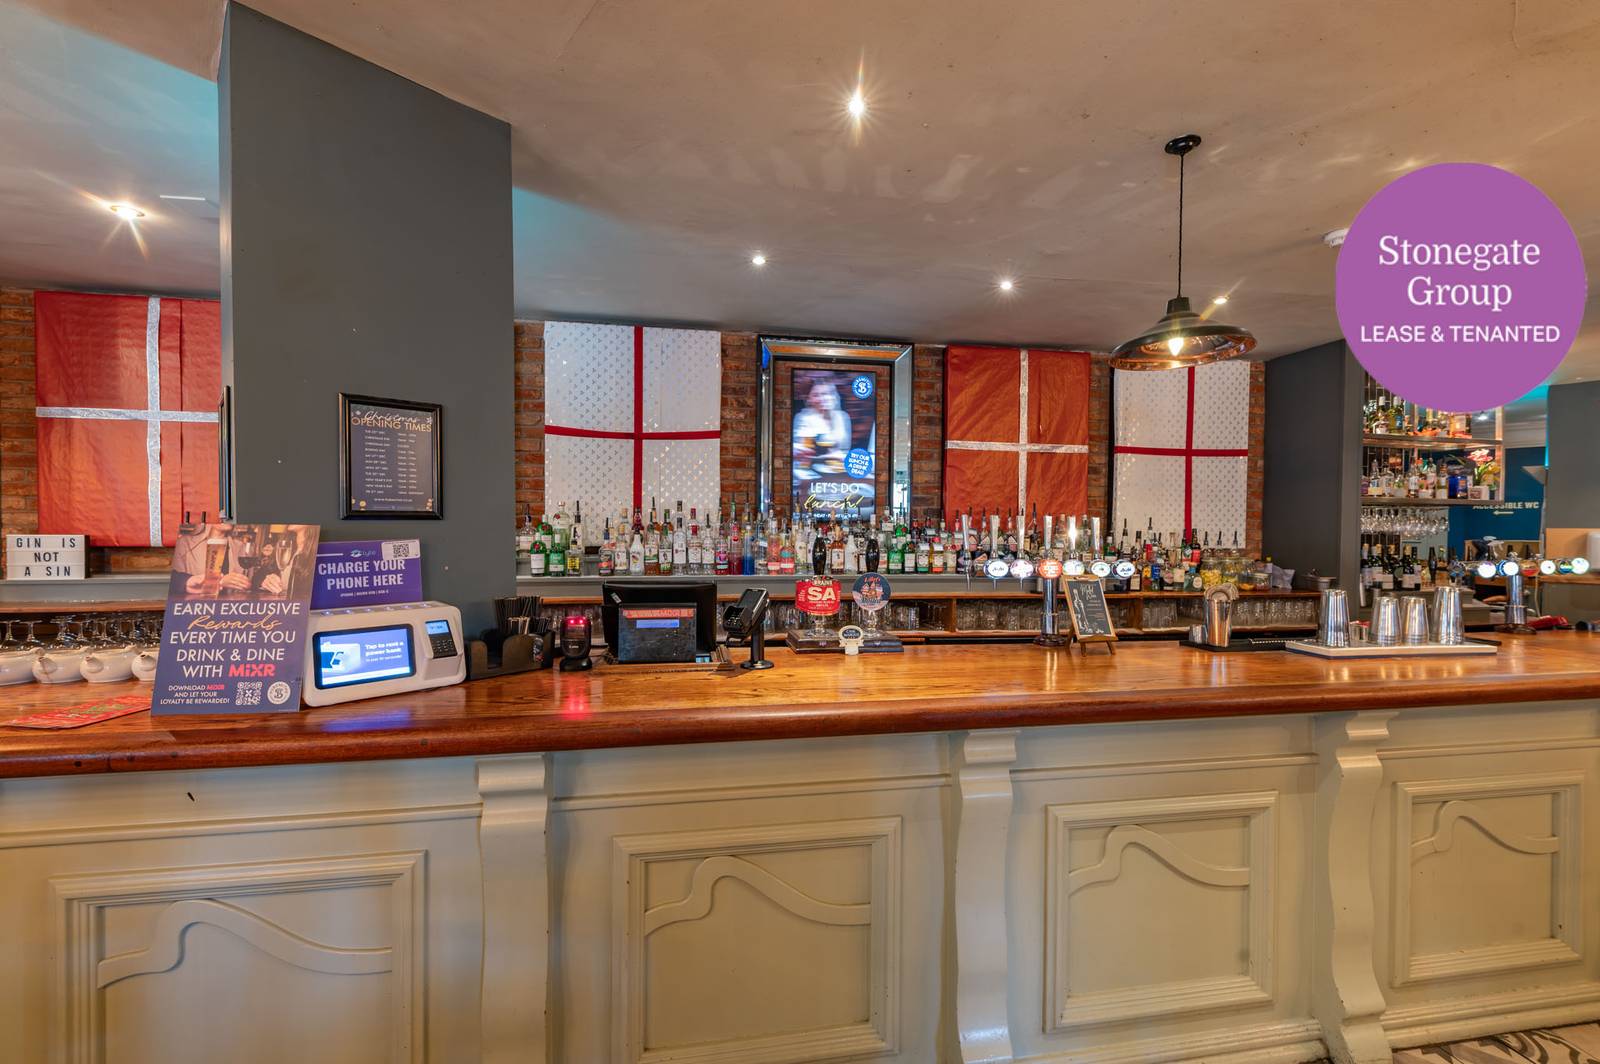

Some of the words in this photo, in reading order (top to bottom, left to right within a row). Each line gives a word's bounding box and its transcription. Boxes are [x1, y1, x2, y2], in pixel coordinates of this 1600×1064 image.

[351, 416, 401, 429] OPENING
[404, 422, 432, 432] TIMES
[840, 482, 860, 493] DO
[16, 537, 42, 548] GIN
[62, 537, 76, 548] IS
[34, 552, 59, 563] NOT
[24, 566, 31, 576] A
[46, 566, 71, 577] SIN
[318, 561, 370, 575] CHARGE
[373, 559, 405, 572] YOUR
[326, 576, 369, 590] PHONE
[373, 573, 404, 586] HERE
[807, 586, 837, 601] SA
[173, 602, 216, 615] EARN
[220, 602, 301, 616] EXCLUSIVE
[187, 614, 282, 631] Rewards
[170, 631, 217, 644] EVERY
[220, 631, 257, 644] TIME
[262, 630, 296, 643] YOU
[176, 649, 226, 662] DRINK
[230, 648, 241, 661] &
[247, 648, 285, 661] DINE
[182, 665, 223, 678] WITH
